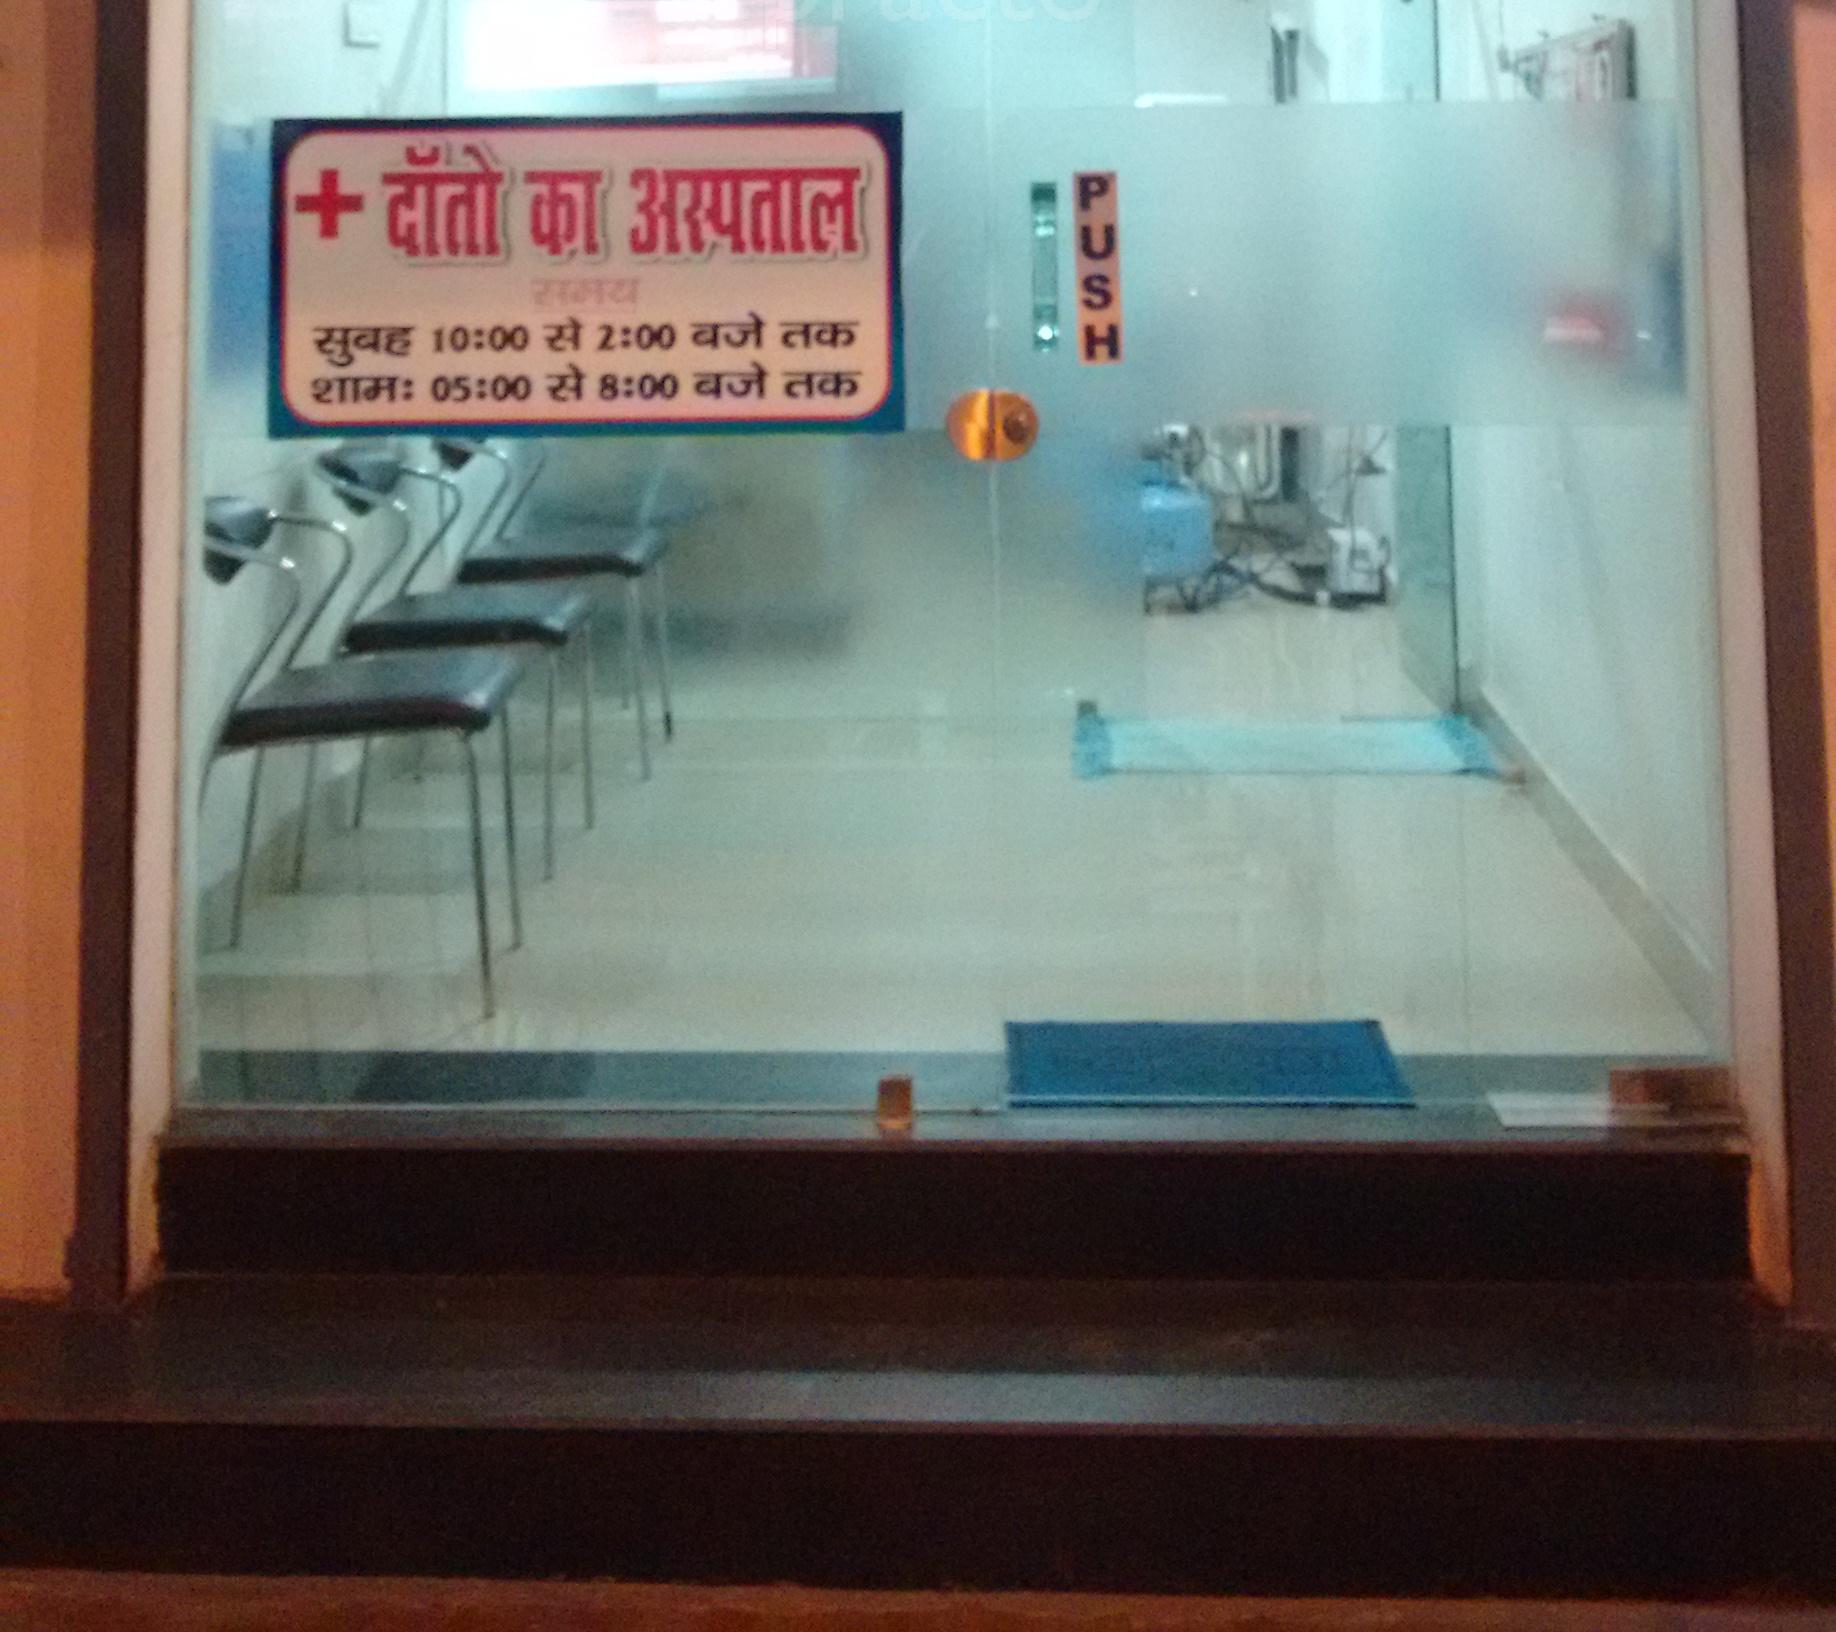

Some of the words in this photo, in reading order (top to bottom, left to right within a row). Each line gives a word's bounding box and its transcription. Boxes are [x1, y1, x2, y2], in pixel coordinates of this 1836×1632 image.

[523, 169, 604, 257] का
[629, 166, 864, 255] अस्पताल
[1077, 174, 1120, 362] PUSH
[312, 326, 415, 367] सुबह
[432, 325, 530, 353] 10:00
[543, 316, 584, 352] से
[597, 323, 676, 351] 2:00
[690, 310, 766, 350] बजे
[778, 321, 860, 350] तक
[431, 374, 532, 403] 05:00
[545, 363, 585, 403] से
[598, 372, 679, 401] 8:00
[693, 360, 769, 399] बजे
[781, 370, 863, 399] तक
